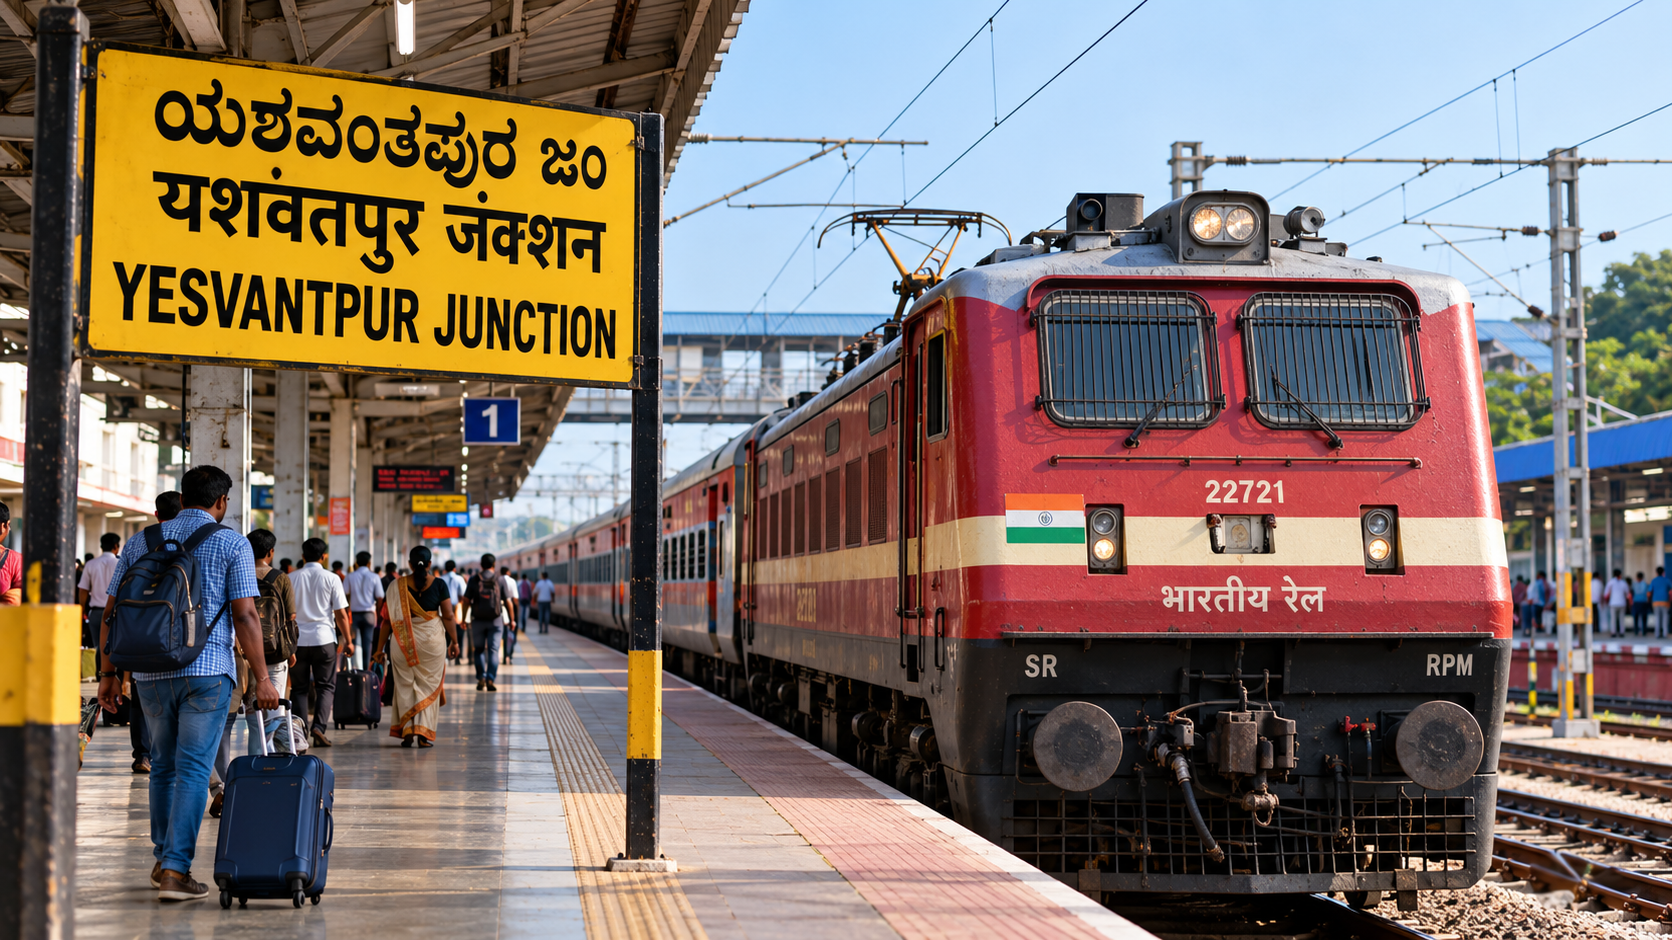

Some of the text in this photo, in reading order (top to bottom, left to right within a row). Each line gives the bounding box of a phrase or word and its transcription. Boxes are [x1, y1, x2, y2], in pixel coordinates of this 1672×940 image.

[155, 79, 607, 189] ಯಶವಂತಪುರ ಜಂ
[153, 167, 606, 274] यशवंतपुर जंक्शन
[113, 262, 616, 359] YESVANTPUR JUNCTION
[481, 404, 498, 438] 1
[1204, 479, 1285, 504] 22721
[1160, 575, 1327, 613] भारतीय रेल
[1024, 654, 1058, 678] SR
[1426, 653, 1473, 677] RPM
